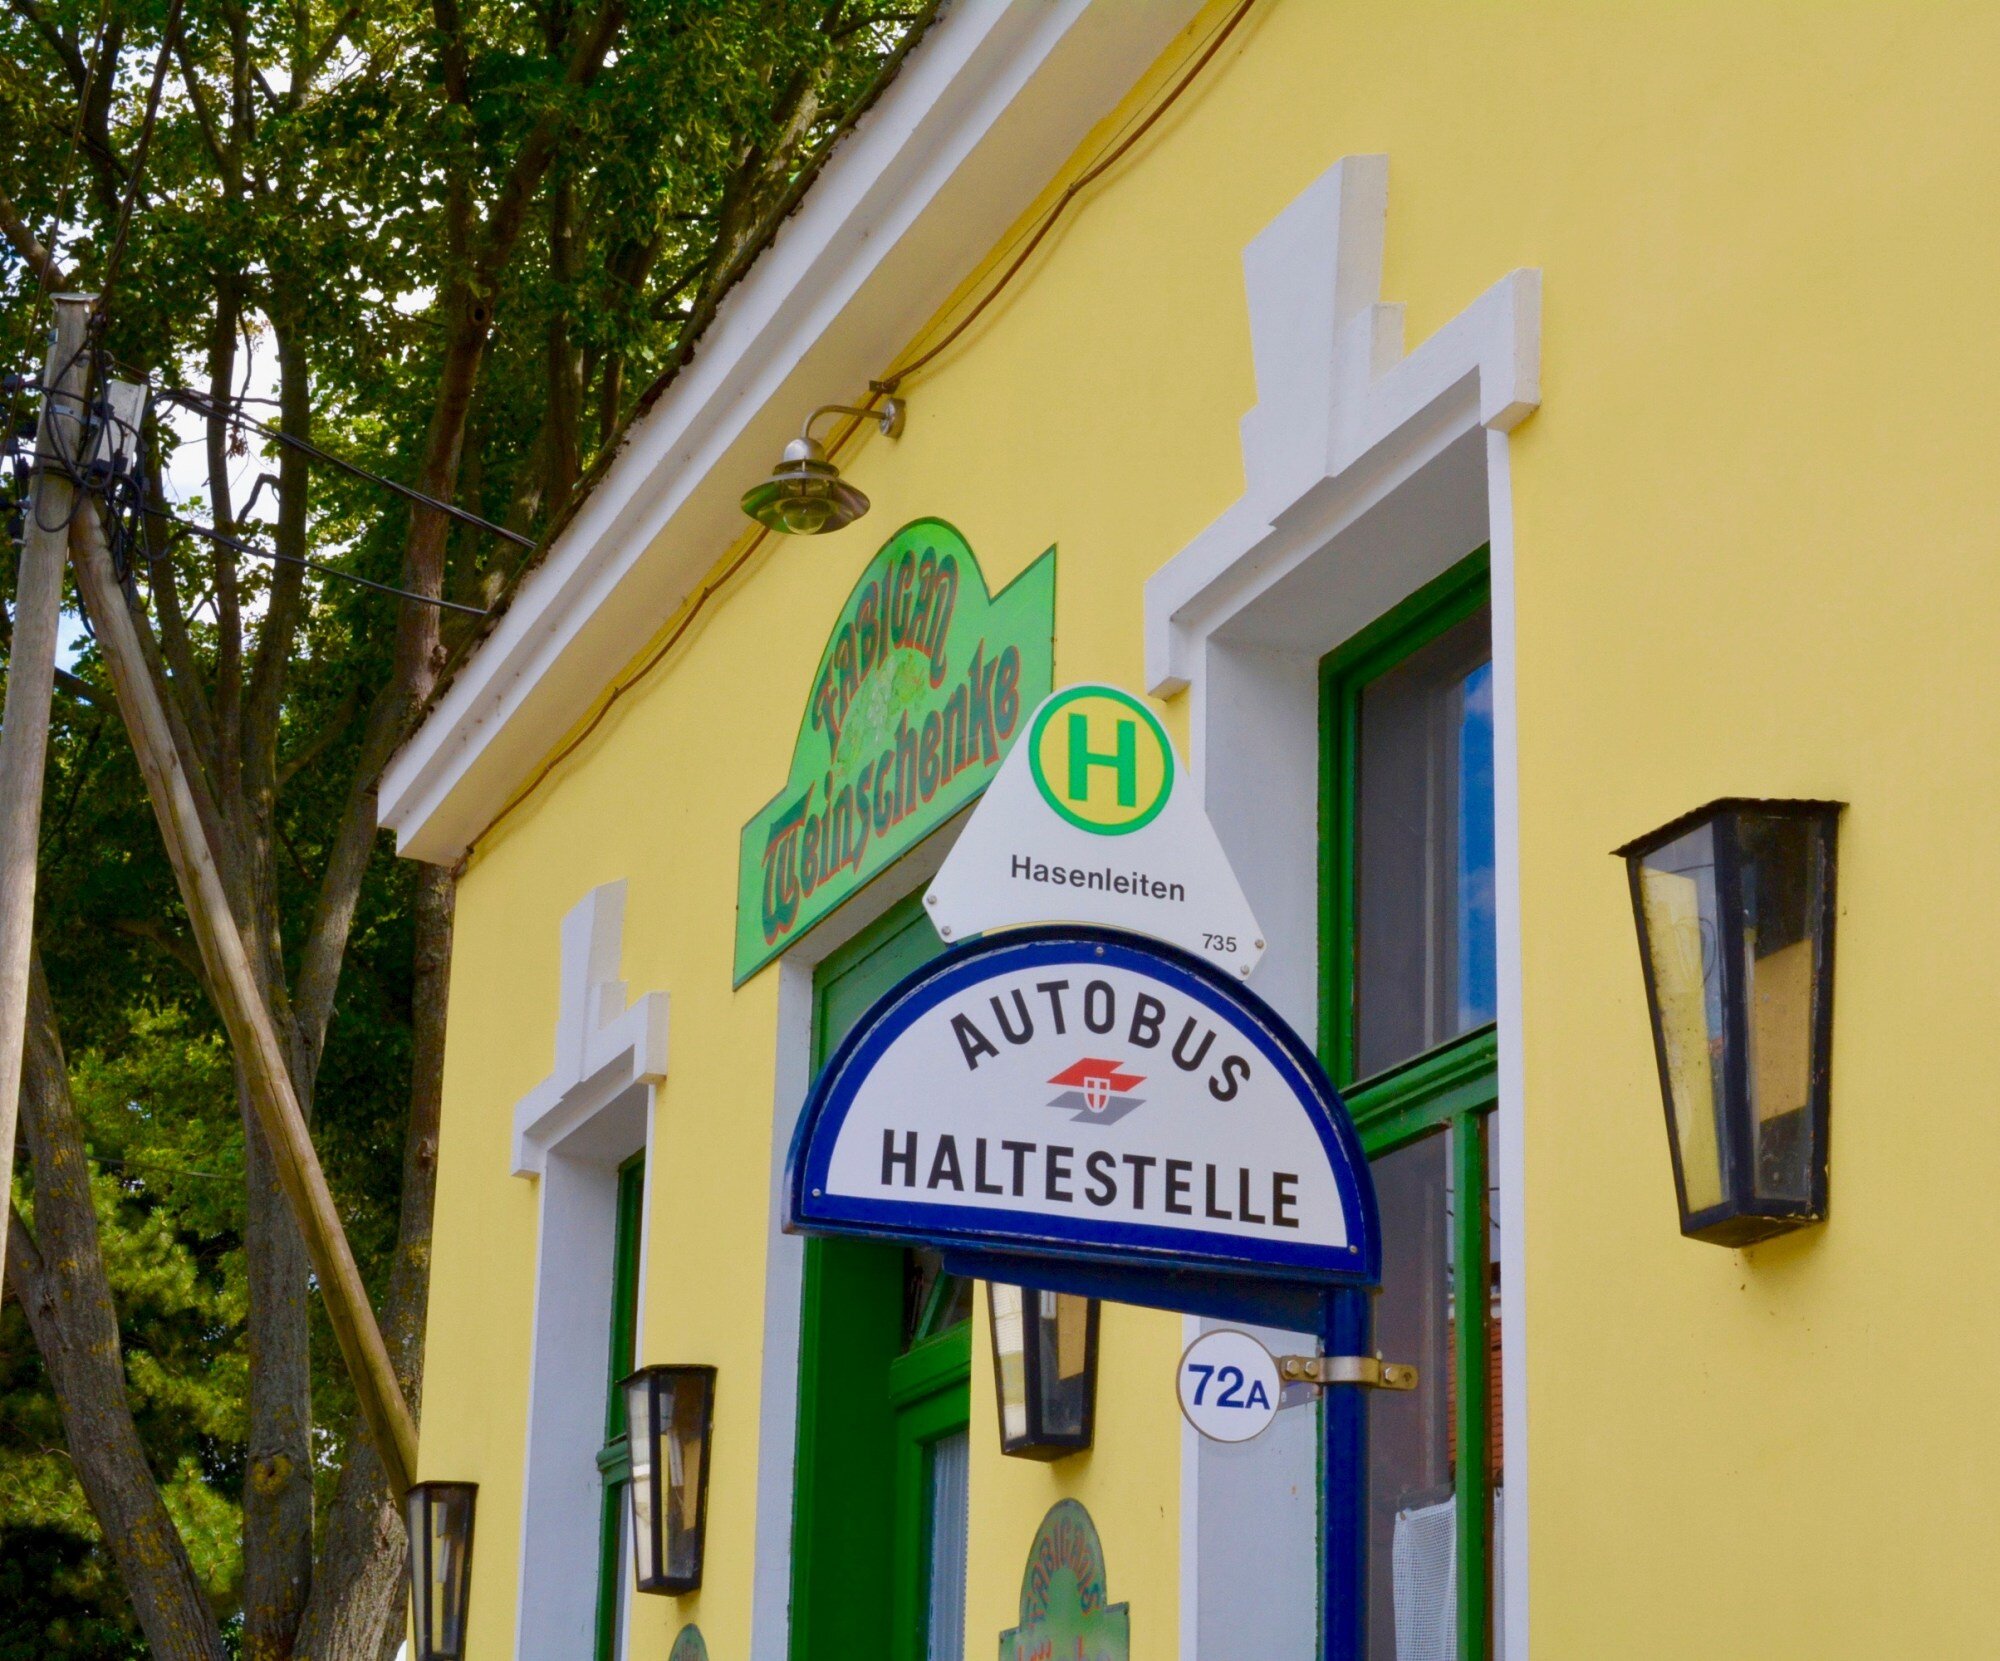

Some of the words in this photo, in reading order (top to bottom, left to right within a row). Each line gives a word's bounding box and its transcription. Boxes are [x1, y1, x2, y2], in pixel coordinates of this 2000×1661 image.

[1068, 712, 1136, 807] H
[1011, 855, 1185, 901] Hasenleiten
[1202, 933, 1237, 953] 735
[949, 979, 1251, 1102] AUTOBUS
[880, 1128, 1300, 1228] HALTESTELLE
[1188, 1363, 1271, 1410] 72A
